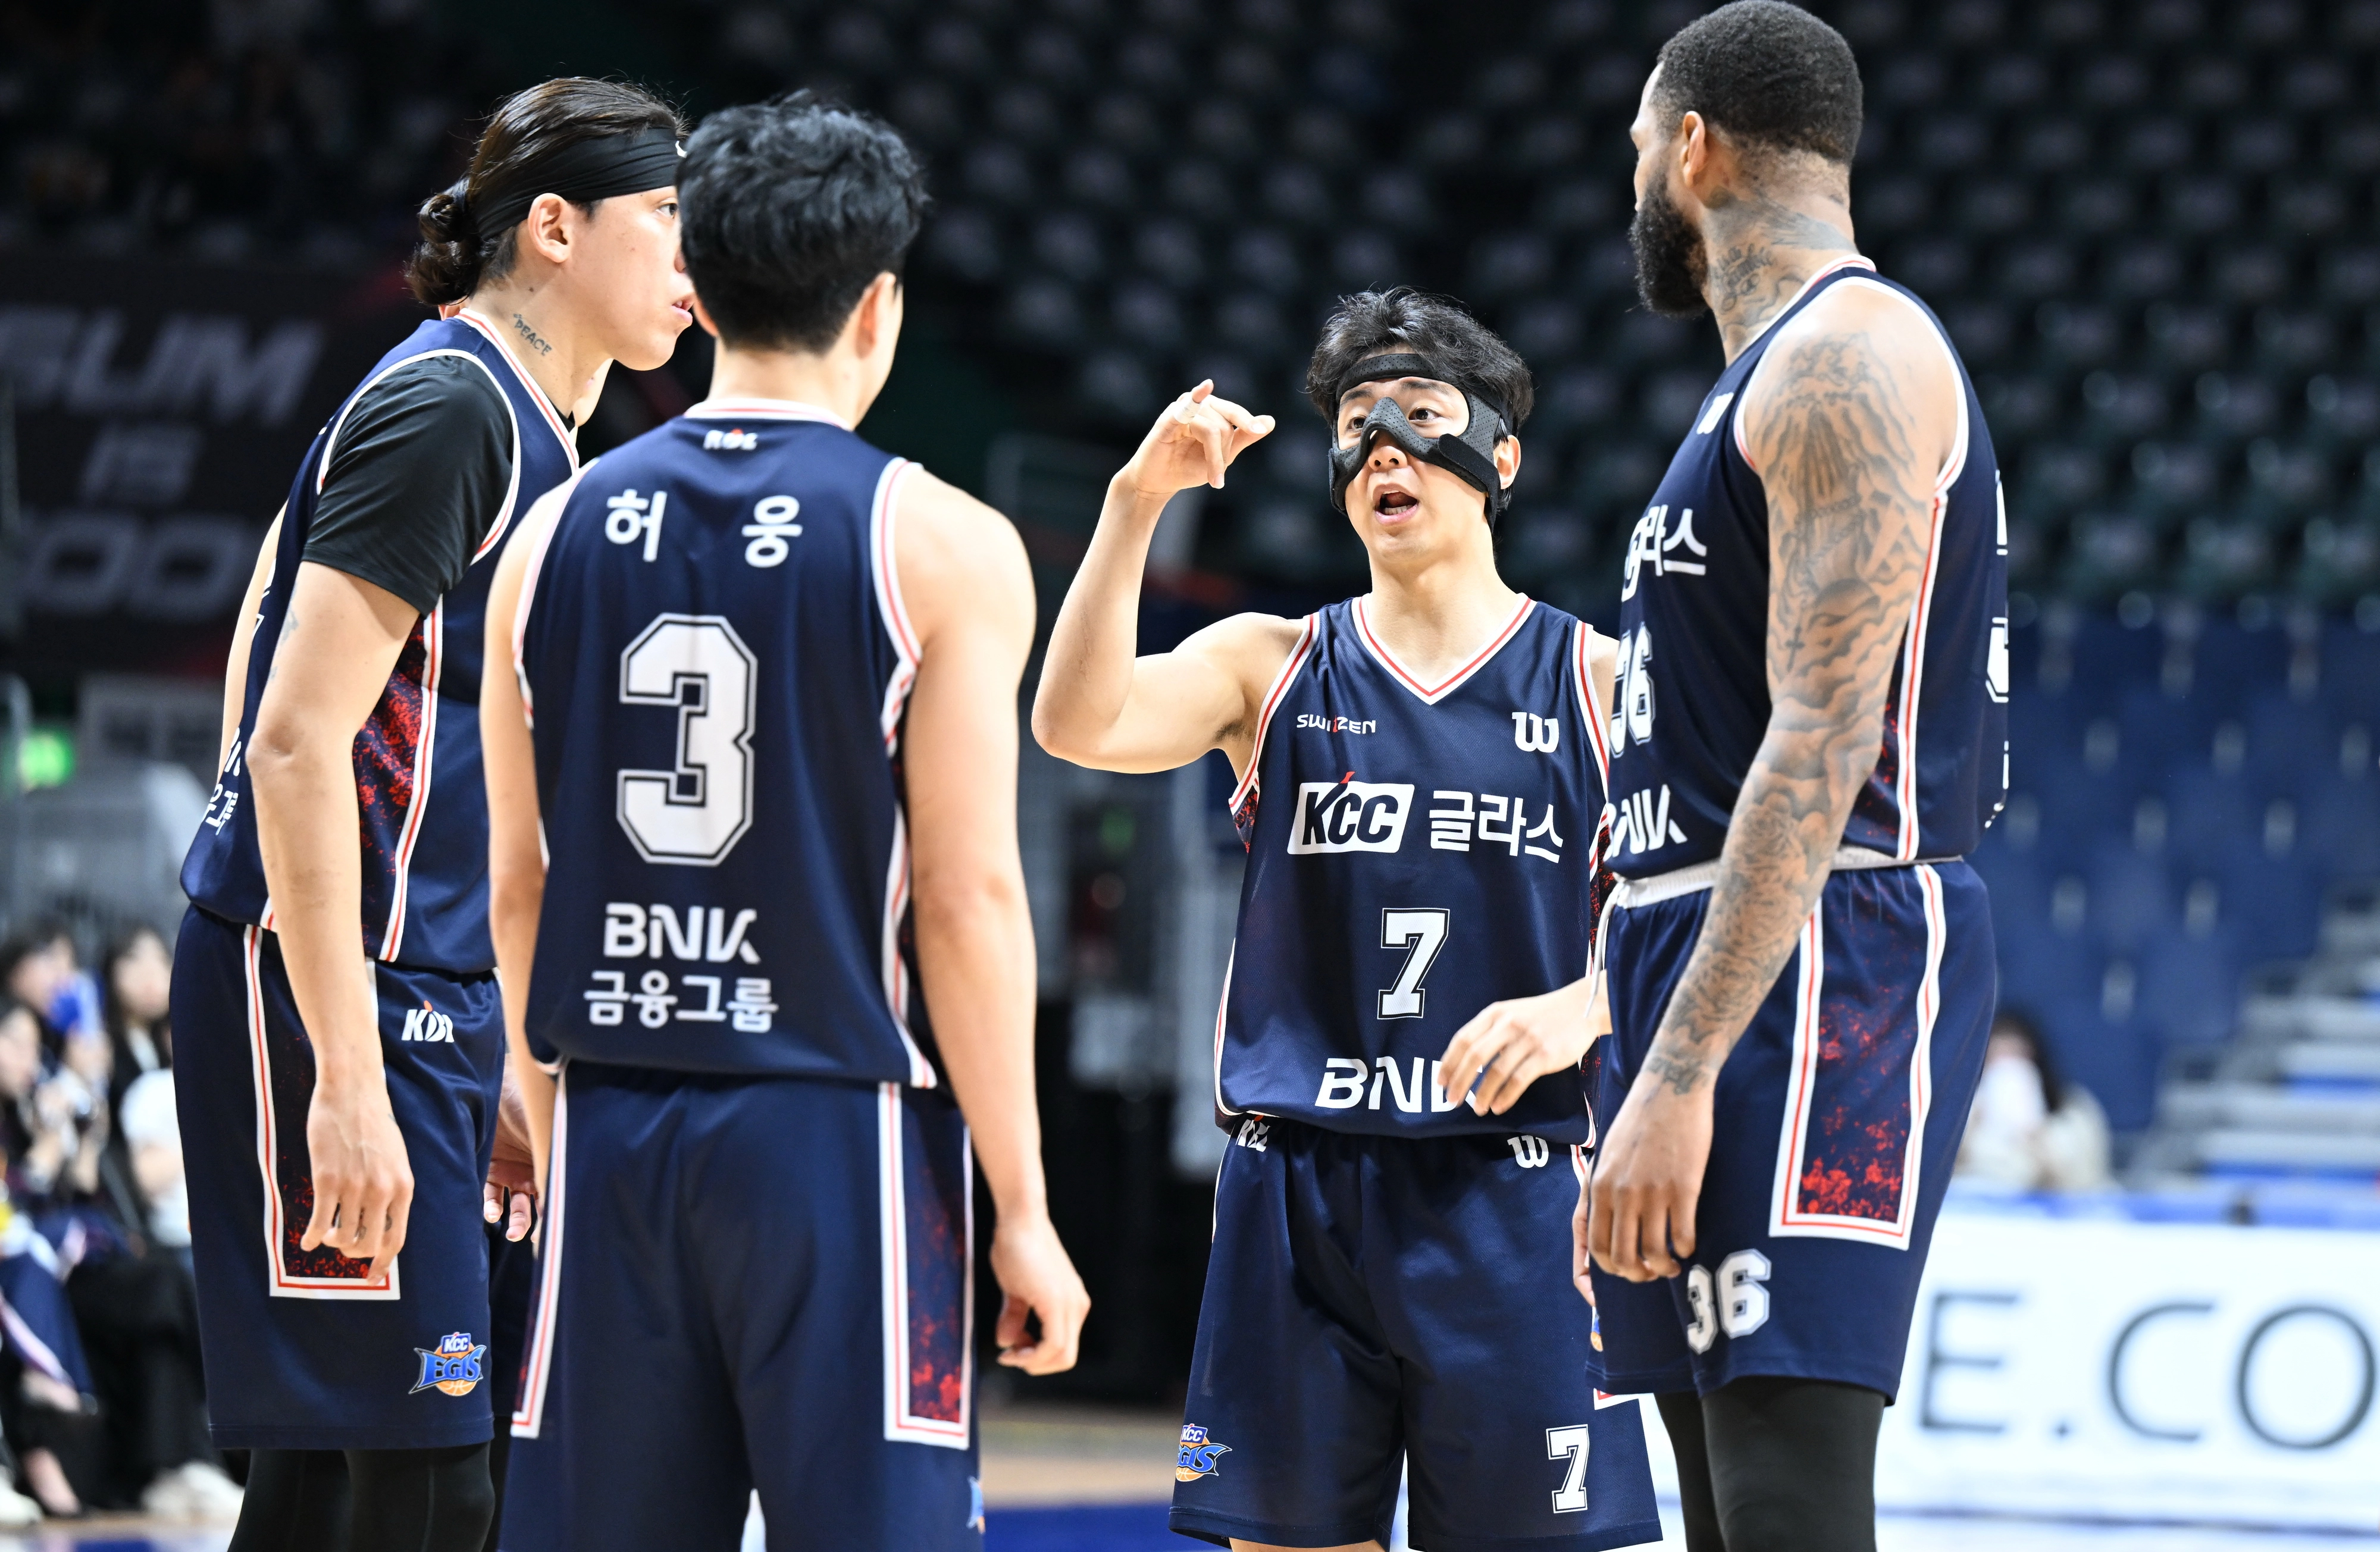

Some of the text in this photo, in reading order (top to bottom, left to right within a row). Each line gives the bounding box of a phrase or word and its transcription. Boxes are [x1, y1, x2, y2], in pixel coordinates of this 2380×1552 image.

[605, 488, 803, 568] 허 웅
[616, 612, 759, 868] 3
[1301, 772, 1564, 864] KCC 글라스
[603, 902, 762, 964] BNK
[1377, 907, 1451, 1020] 7
[583, 969, 779, 1034] 금융그룹
[1686, 1248, 1772, 1355] 36
[416, 1346, 487, 1389] EGIS
[444, 1332, 469, 1353] KCC
[1178, 1444, 1229, 1473] GIS
[1182, 1424, 1203, 1442] KCC
[1546, 1424, 1590, 1513] 7
